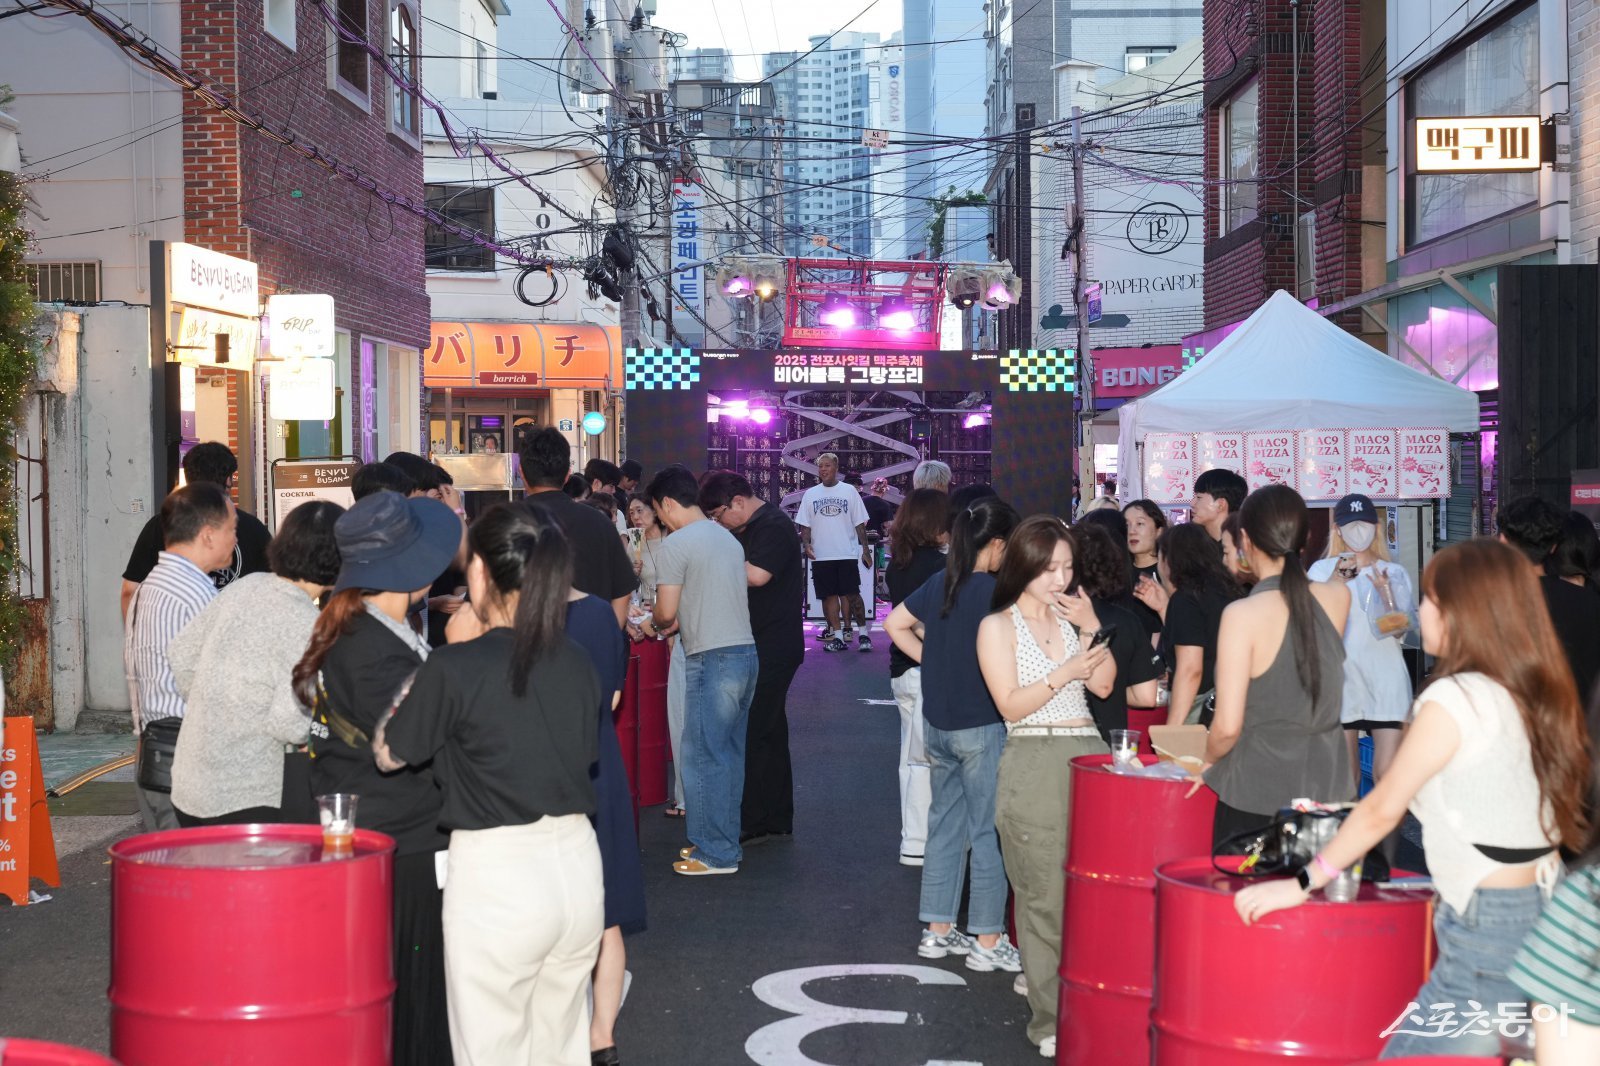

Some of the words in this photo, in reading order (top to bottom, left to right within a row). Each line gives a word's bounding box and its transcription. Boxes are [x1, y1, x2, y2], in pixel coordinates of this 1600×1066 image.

[1426, 126, 1530, 160] 맥구피
[224, 267, 253, 295] BUSAN
[1105, 277, 1149, 295] PAPER
[431, 331, 585, 368] バリチ
[775, 355, 807, 366] 2025
[873, 355, 923, 367] 맥주축제
[493, 374, 527, 383] barrich
[850, 366, 923, 384] 그랑프리
[1253, 438, 1288, 448] MAC9
[1354, 435, 1390, 445] MAC9
[1406, 435, 1441, 444] MAC9
[1253, 448, 1290, 458] PIZZA
[1354, 445, 1391, 455] PIZZA
[1406, 444, 1443, 454] PIZZA
